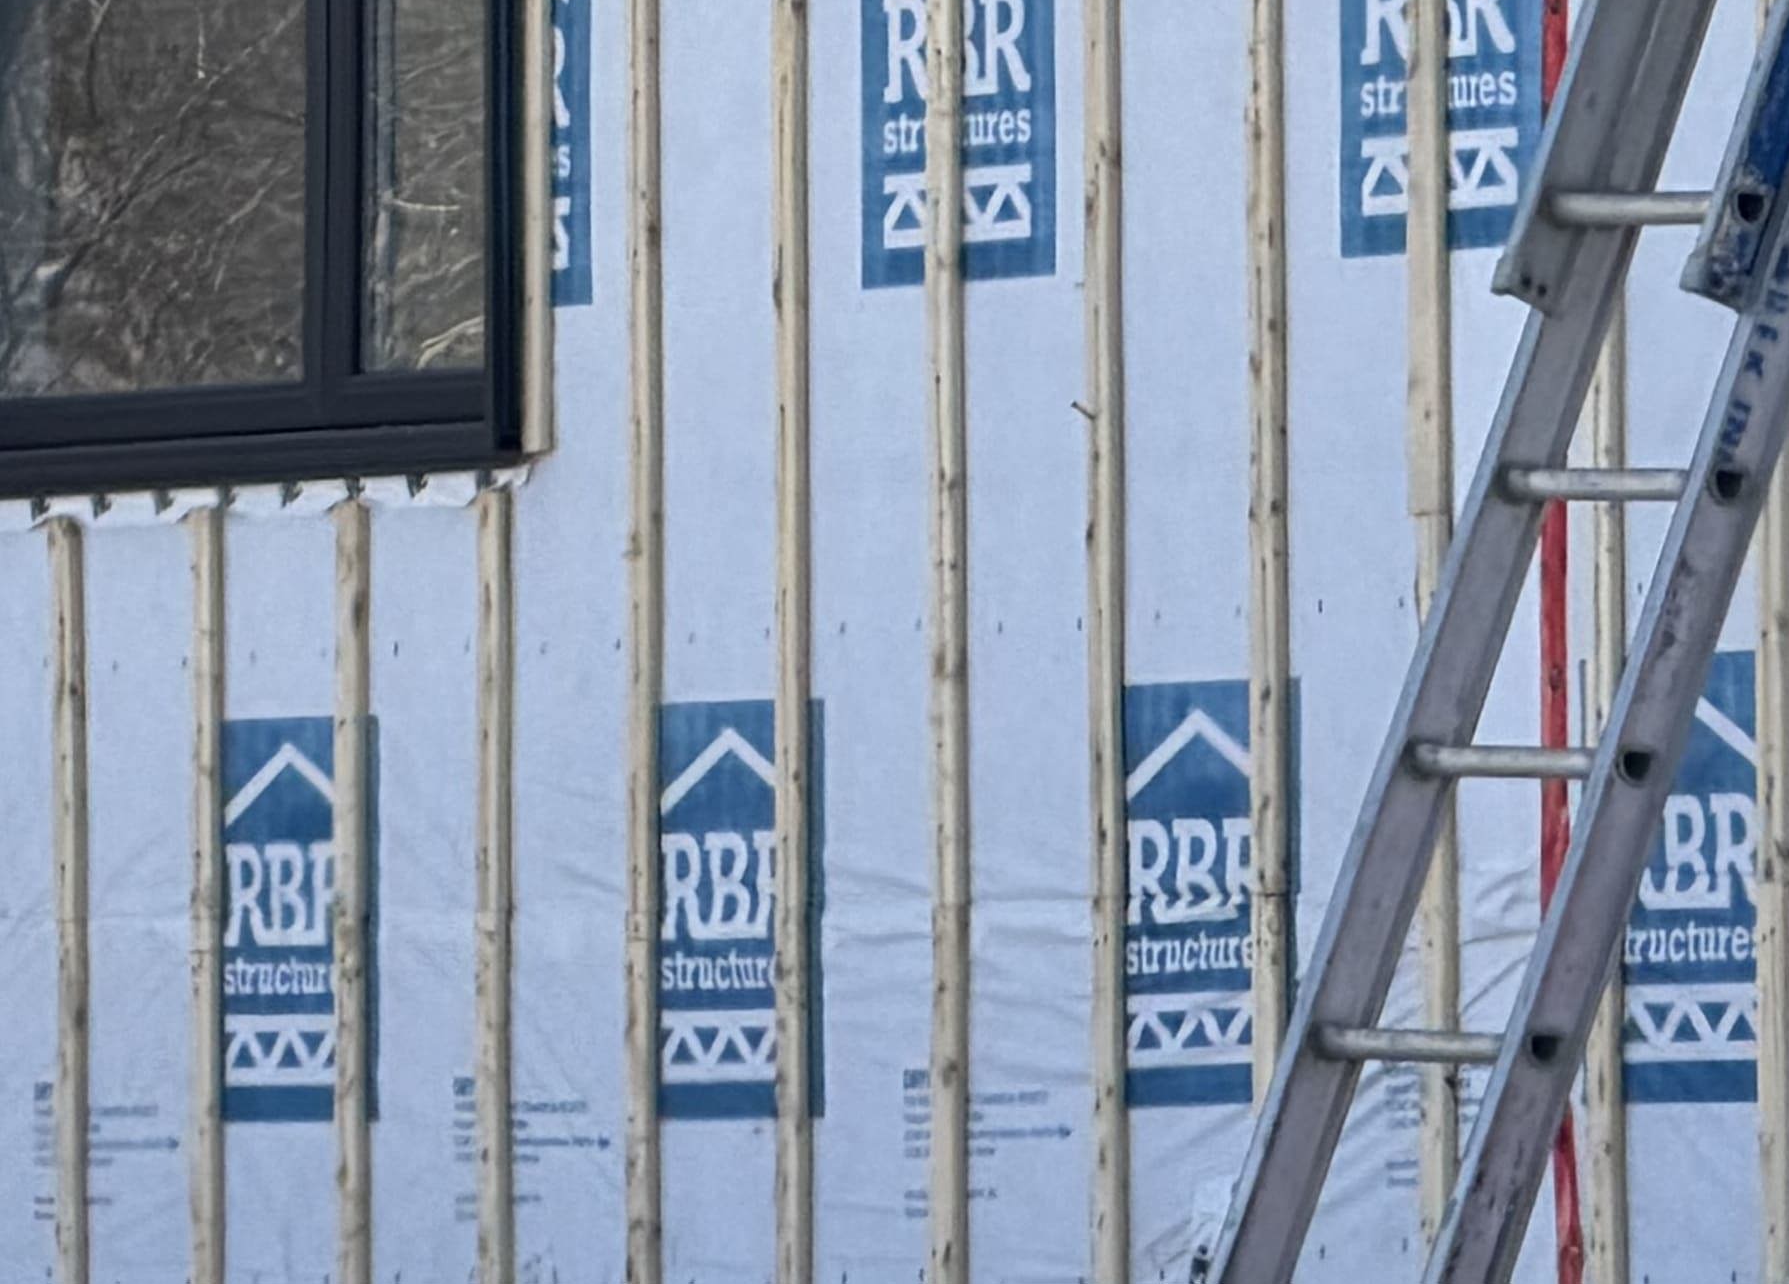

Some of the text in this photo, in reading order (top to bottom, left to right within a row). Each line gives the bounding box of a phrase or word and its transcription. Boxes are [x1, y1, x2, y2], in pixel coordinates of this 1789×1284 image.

[1360, 68, 1516, 117] strures
[883, 105, 1031, 153] strures
[1635, 792, 1756, 911] BR
[1127, 928, 1254, 976] structure
